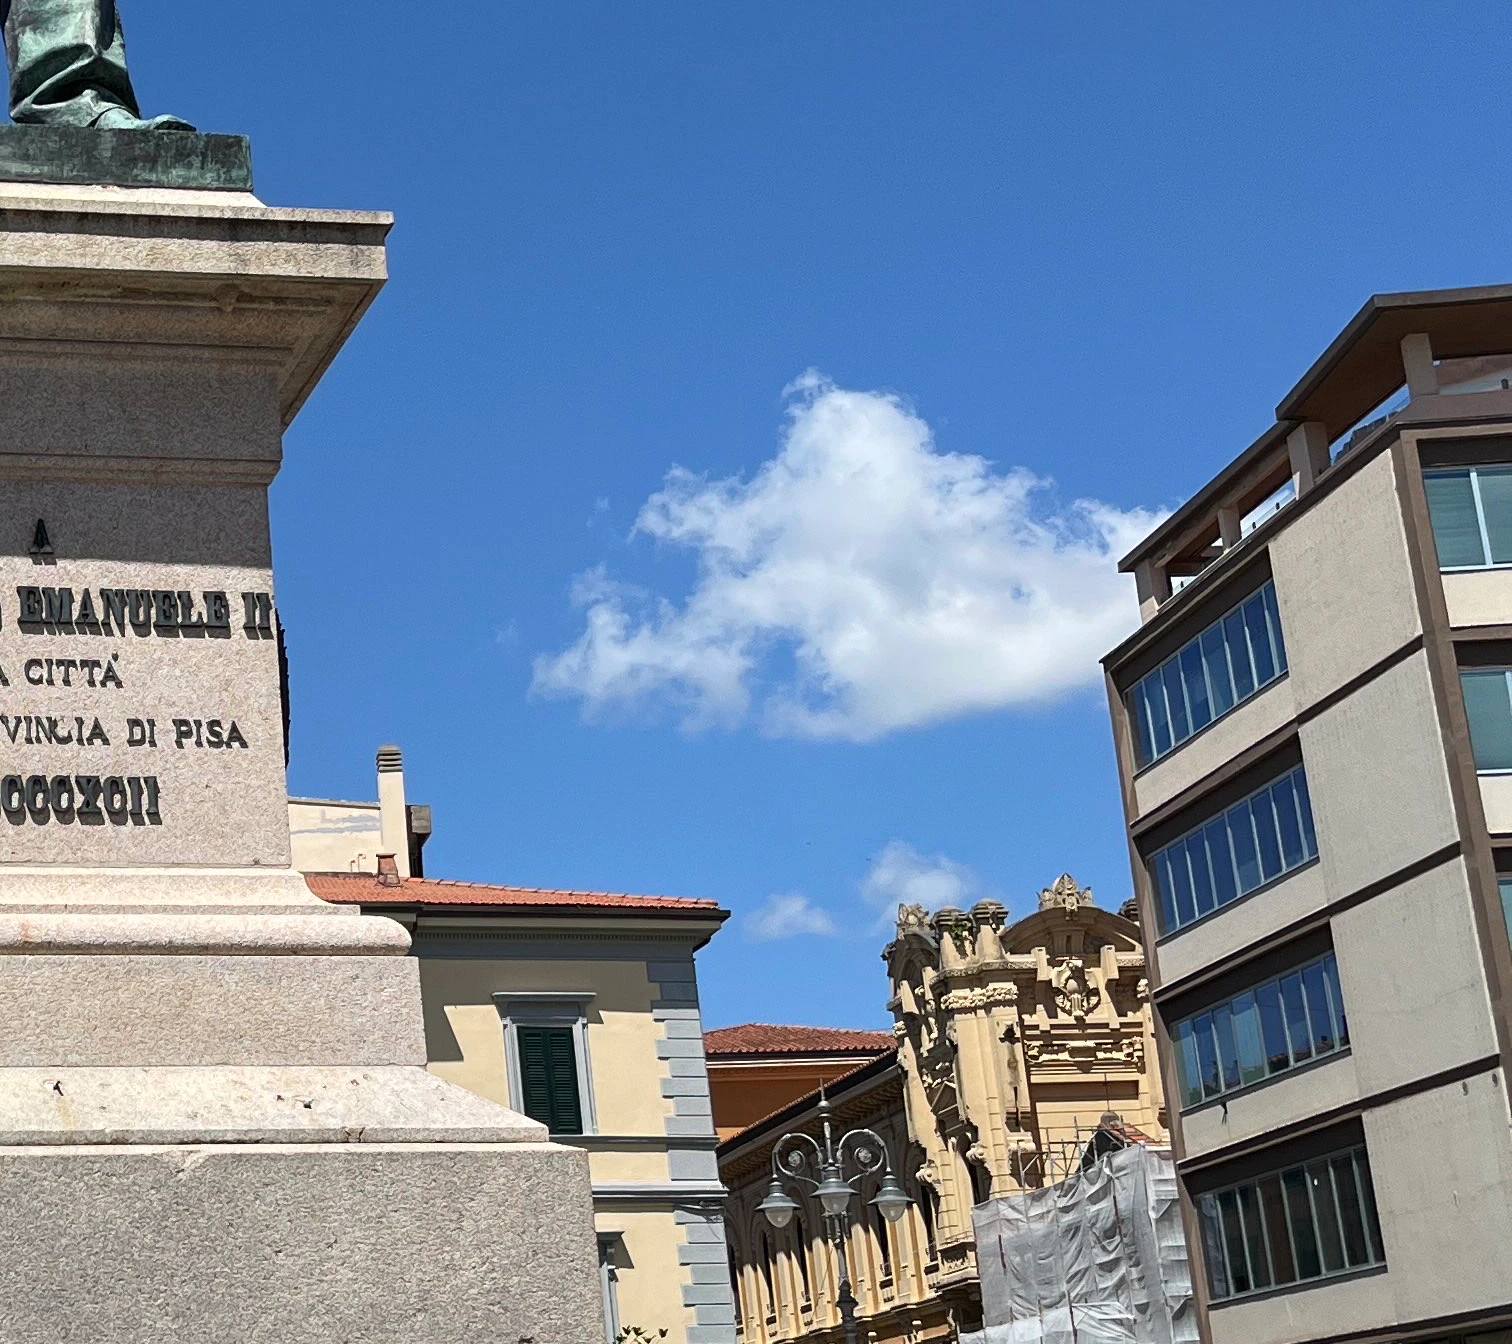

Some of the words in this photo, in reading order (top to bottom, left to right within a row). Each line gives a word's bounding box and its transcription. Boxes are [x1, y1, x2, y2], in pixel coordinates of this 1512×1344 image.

[29, 518, 54, 556] A
[17, 585, 230, 634] EMANUELE
[242, 592, 272, 636] II
[127, 719, 157, 747] DI
[172, 719, 248, 749] PISA
